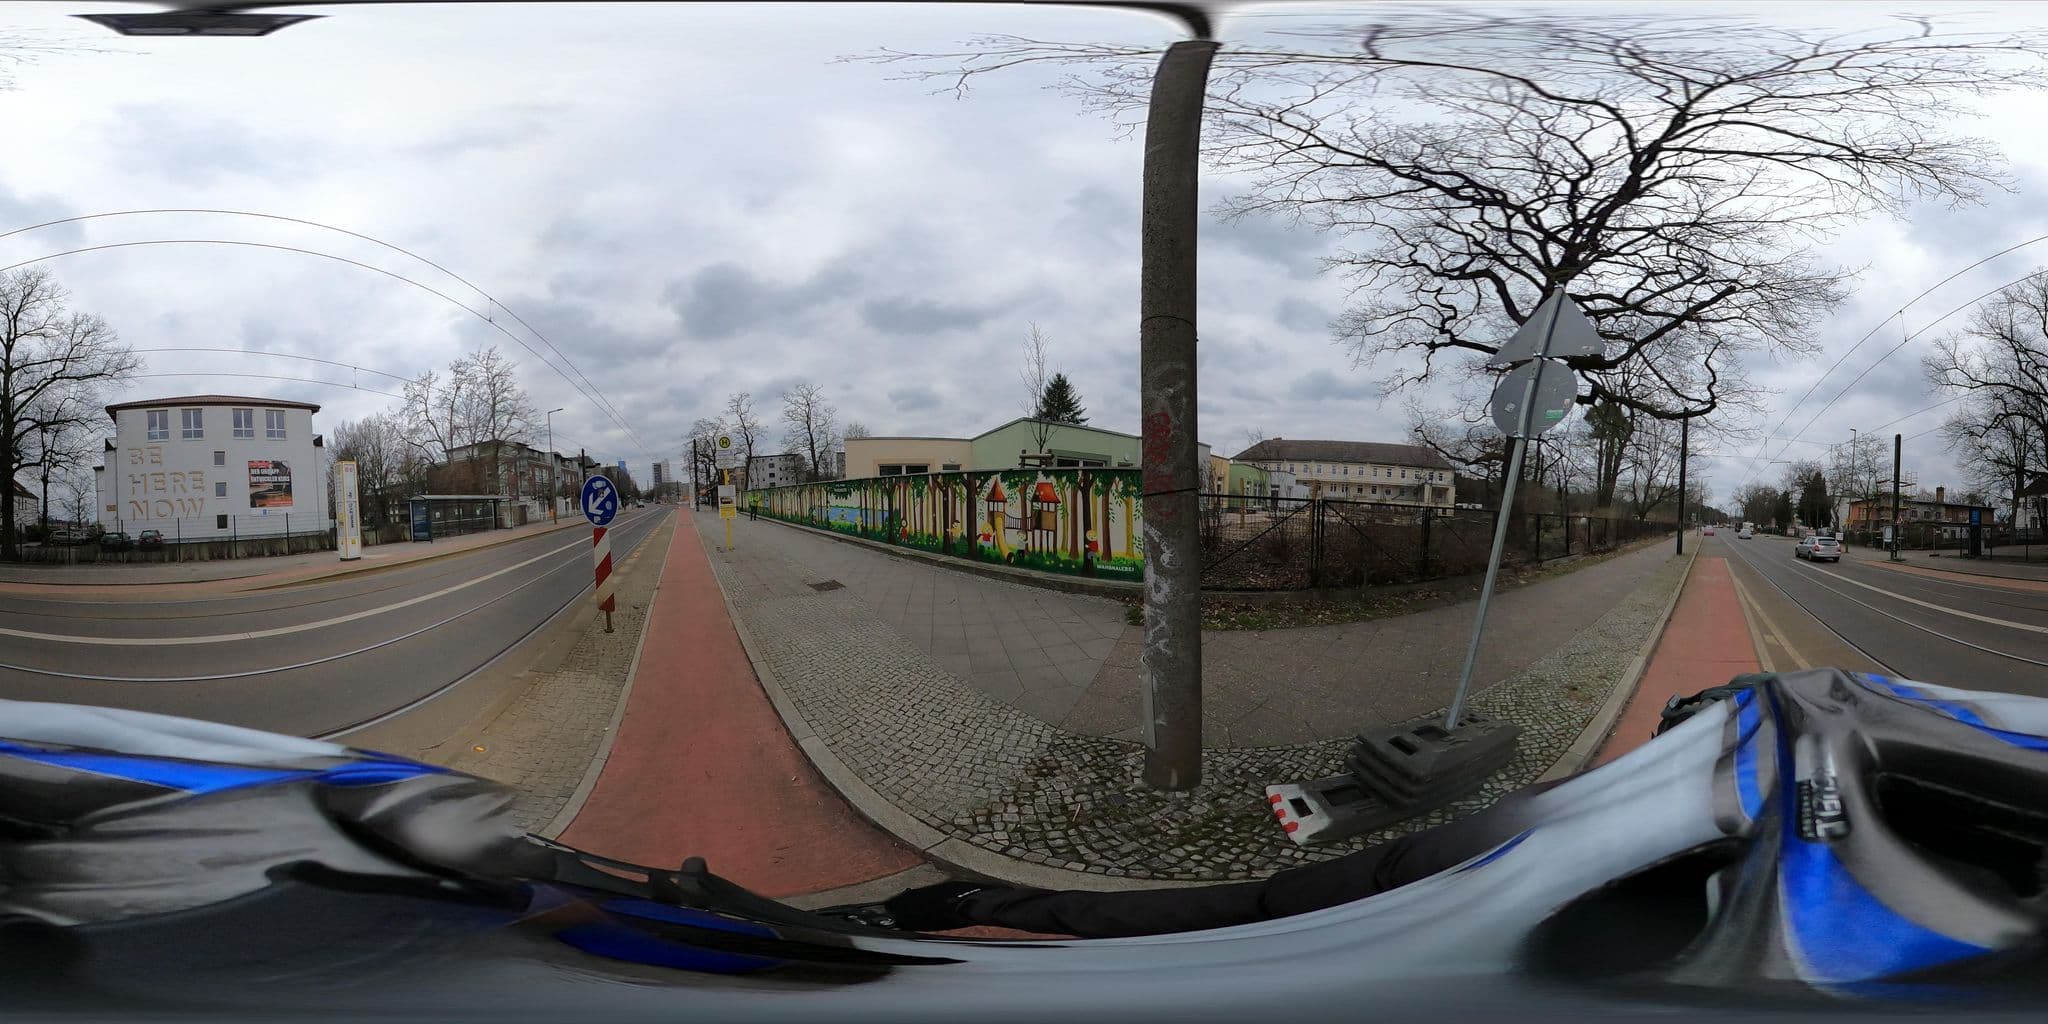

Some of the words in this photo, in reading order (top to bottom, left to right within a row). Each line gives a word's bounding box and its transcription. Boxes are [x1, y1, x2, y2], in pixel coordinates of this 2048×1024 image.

[128, 446, 162, 465] BE
[128, 471, 205, 495] HERE
[128, 498, 205, 521] NOW
